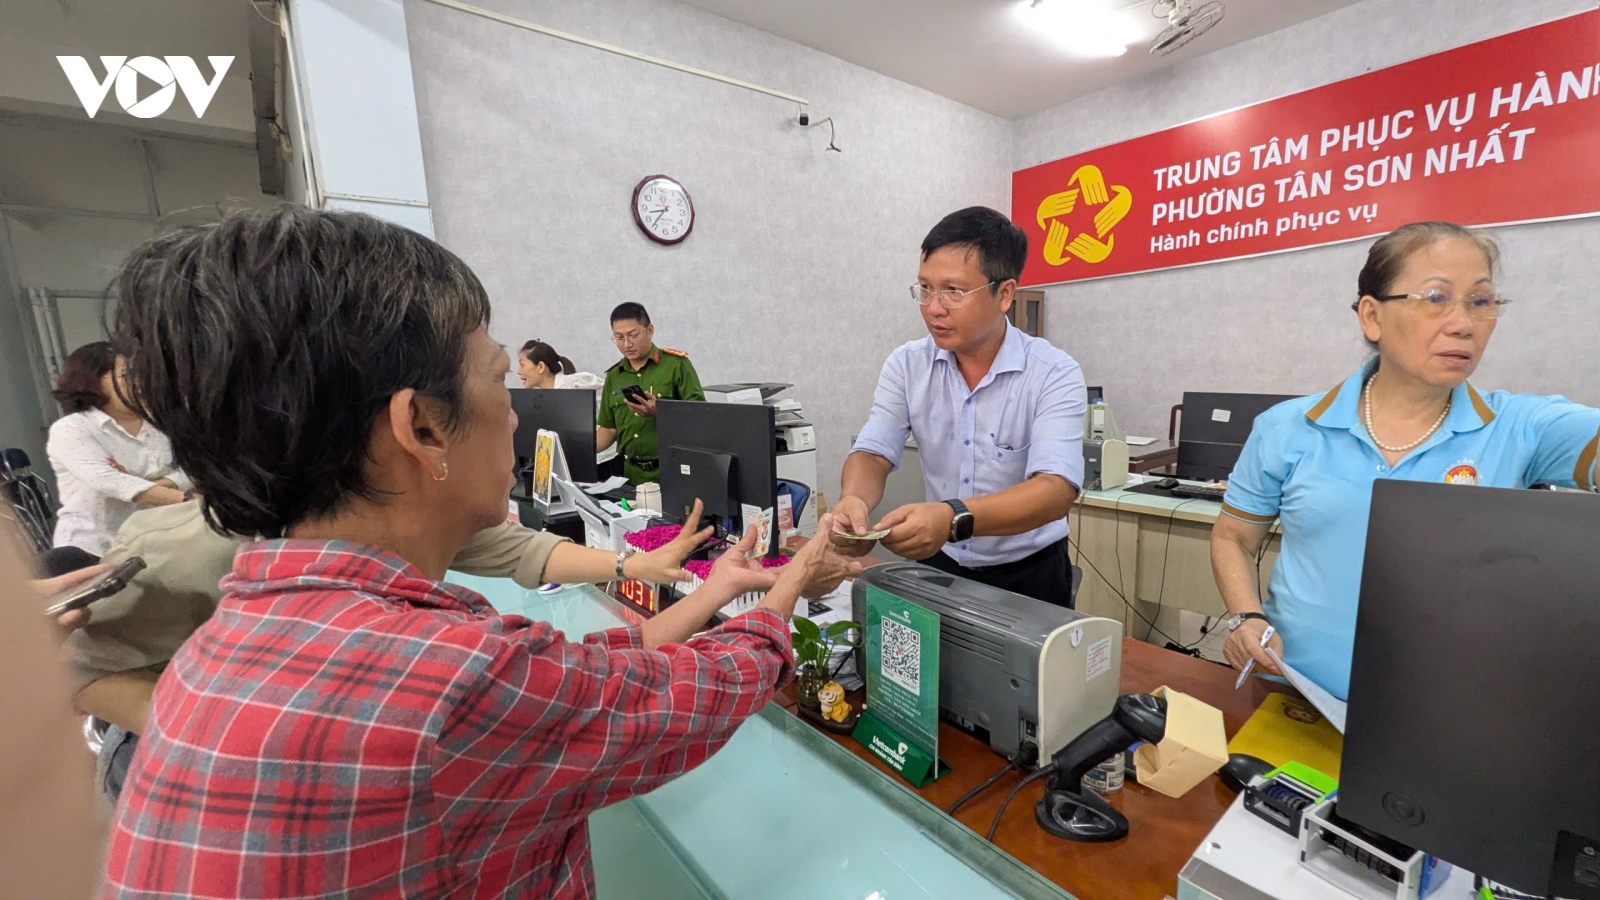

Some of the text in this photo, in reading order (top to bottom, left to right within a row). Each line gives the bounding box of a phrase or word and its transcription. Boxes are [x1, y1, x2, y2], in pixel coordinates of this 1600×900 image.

[1153, 151, 1241, 191] TRUNG
[1249, 134, 1309, 170] TÂM
[1320, 109, 1415, 157] PHỤC
[1424, 92, 1477, 133] VỤ
[1152, 122, 1536, 226] PHƯỜNG TÂN SƠN NHẤT
[651, 187, 656, 195] 11
[644, 194, 652, 202] 10
[677, 199, 683, 207] 2
[679, 209, 686, 217] 3
[645, 215, 652, 223] 8
[662, 228, 669, 236] 6
[1150, 202, 1378, 254] Hành chính phục vụ
[621, 579, 654, 612] 1031
[1075, 629, 1079, 642] 1
[872, 735, 907, 765] Vietcombank
